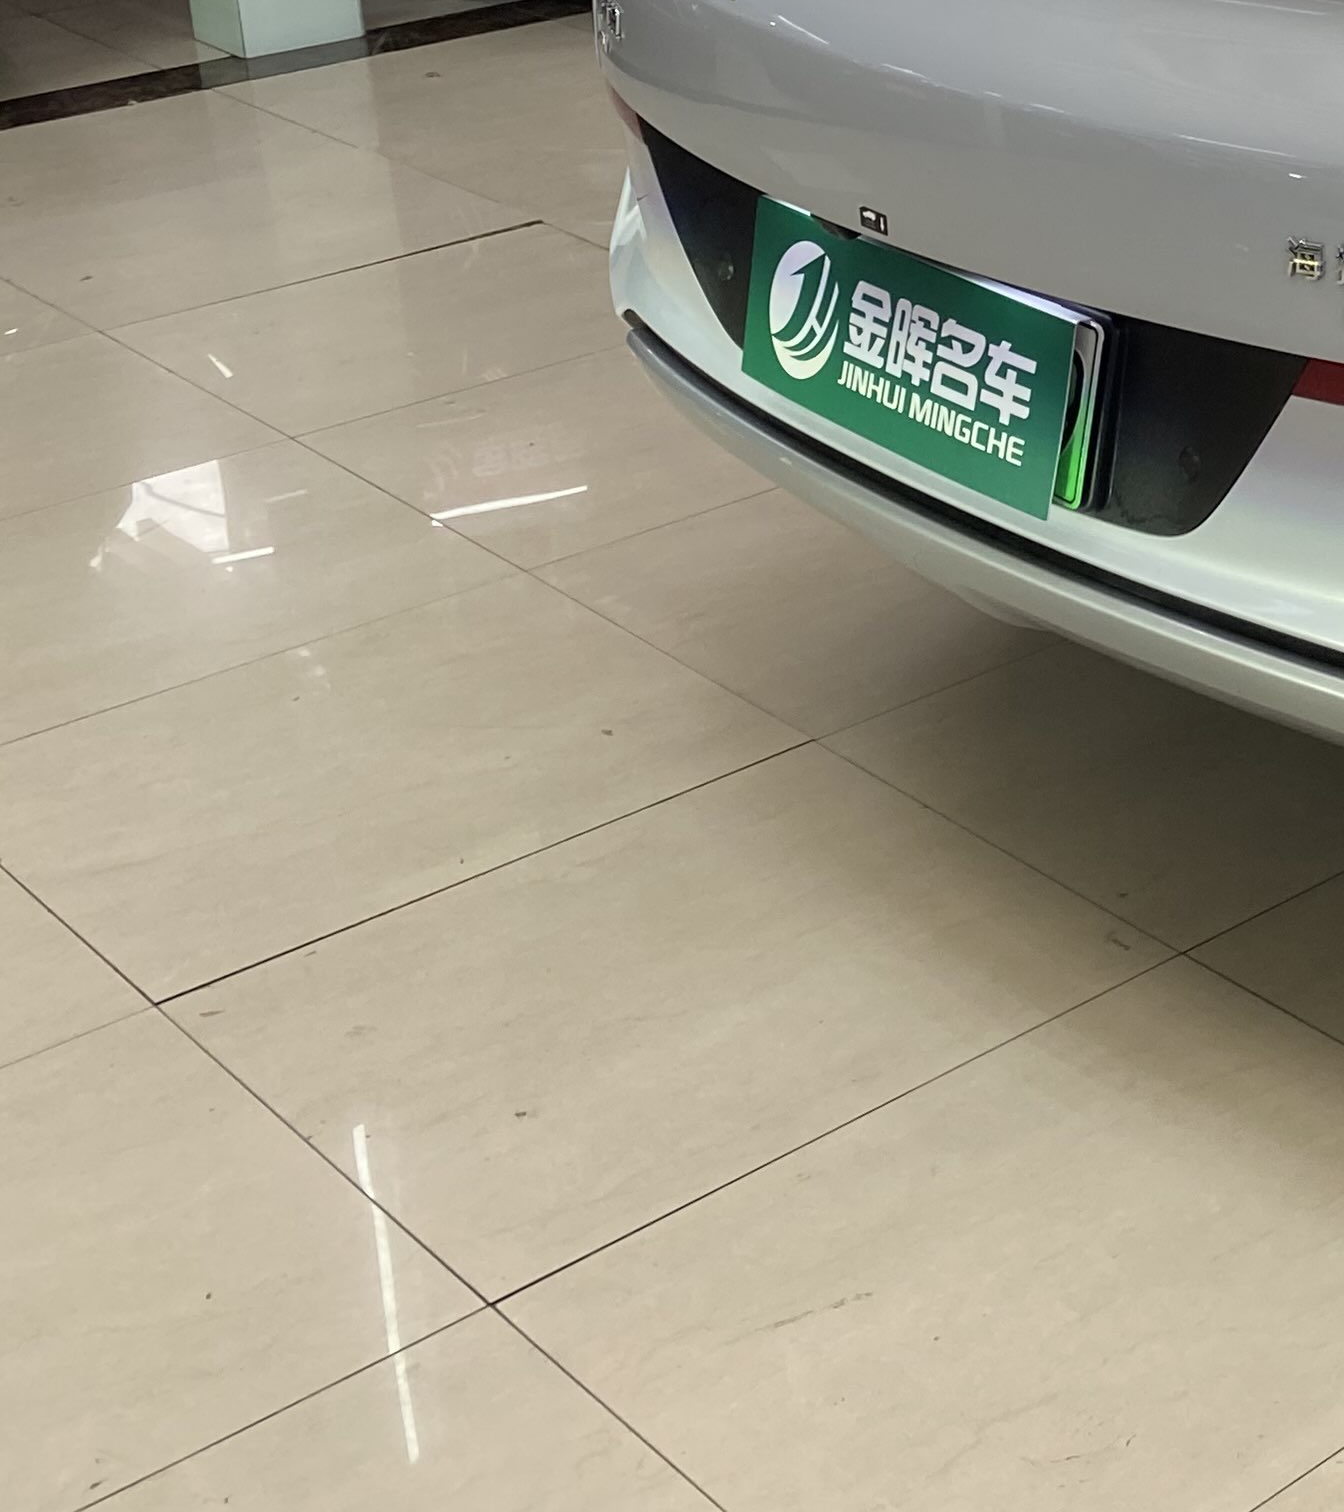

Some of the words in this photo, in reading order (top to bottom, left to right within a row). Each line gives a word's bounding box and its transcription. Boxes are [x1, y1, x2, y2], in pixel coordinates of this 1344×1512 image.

[837, 361, 907, 413] JINHUI
[908, 392, 1026, 467] MINGCHE
[843, 280, 1038, 427] 金晖名车
